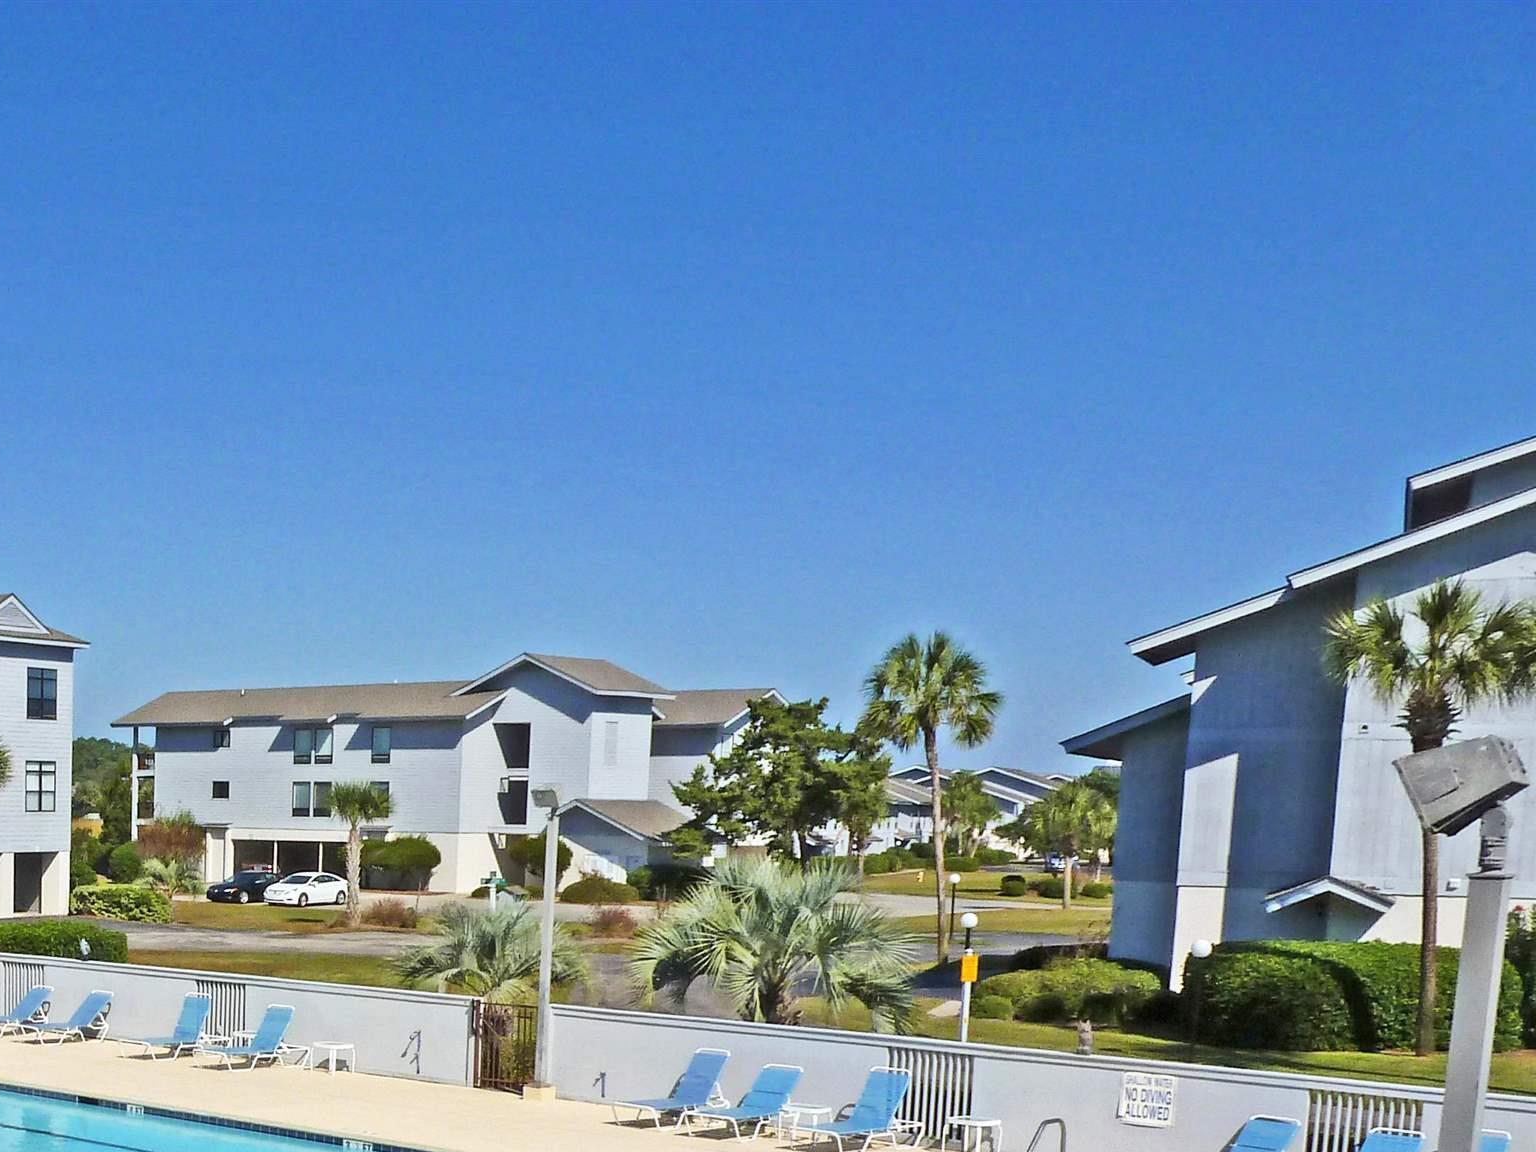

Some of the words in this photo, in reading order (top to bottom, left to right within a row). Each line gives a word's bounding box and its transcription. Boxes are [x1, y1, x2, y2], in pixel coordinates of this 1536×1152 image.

[1125, 1087, 1138, 1102] NO
[1140, 1088, 1172, 1105] DIVING
[1125, 1103, 1170, 1121] ALLOWED
